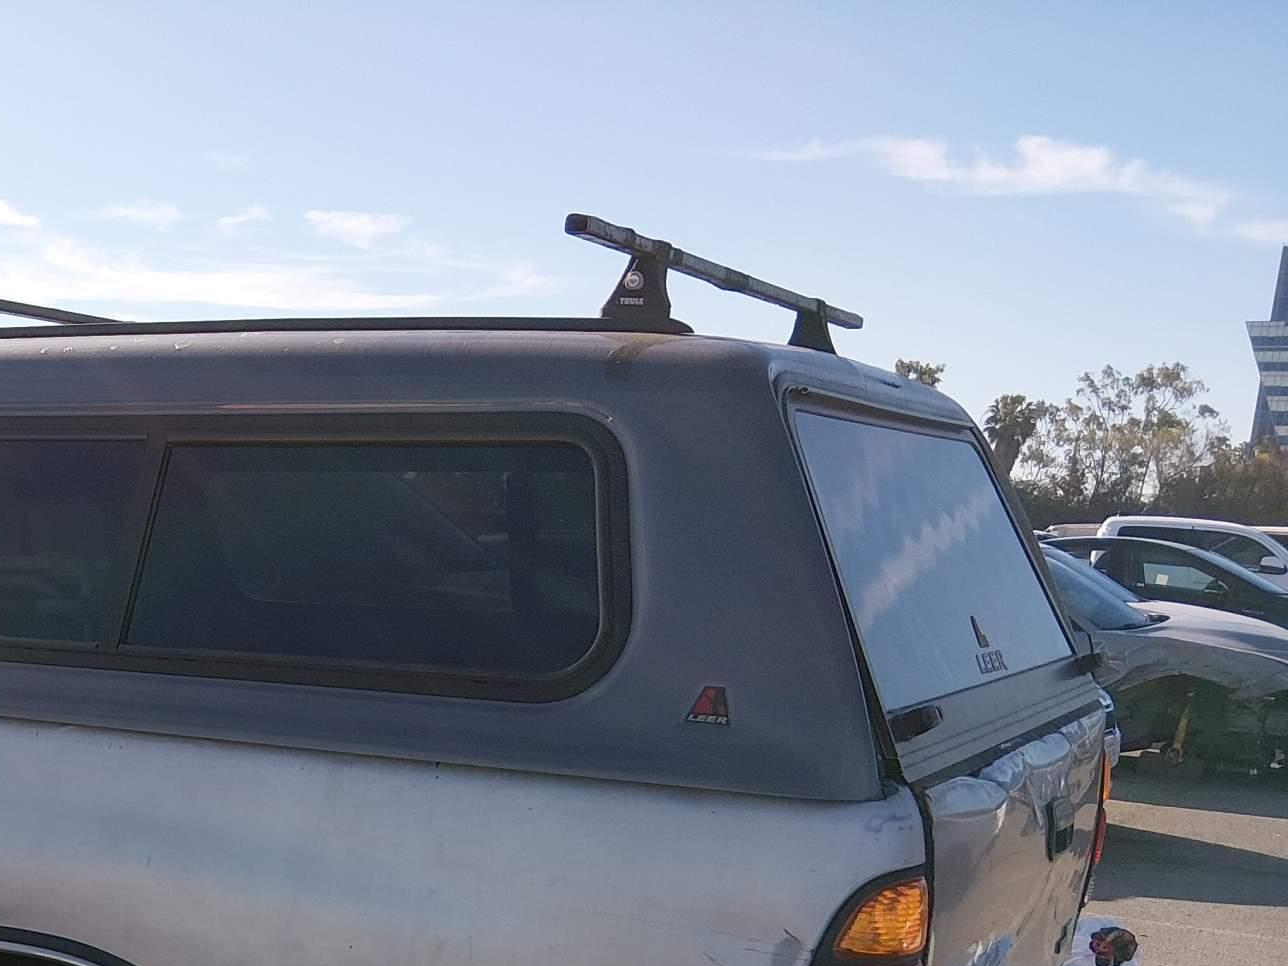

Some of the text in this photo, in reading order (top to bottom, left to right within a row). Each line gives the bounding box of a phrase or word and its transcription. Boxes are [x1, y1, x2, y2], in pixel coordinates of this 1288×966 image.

[619, 297, 644, 305] THULE
[976, 649, 1008, 675] LEER
[687, 714, 728, 725] LEER
